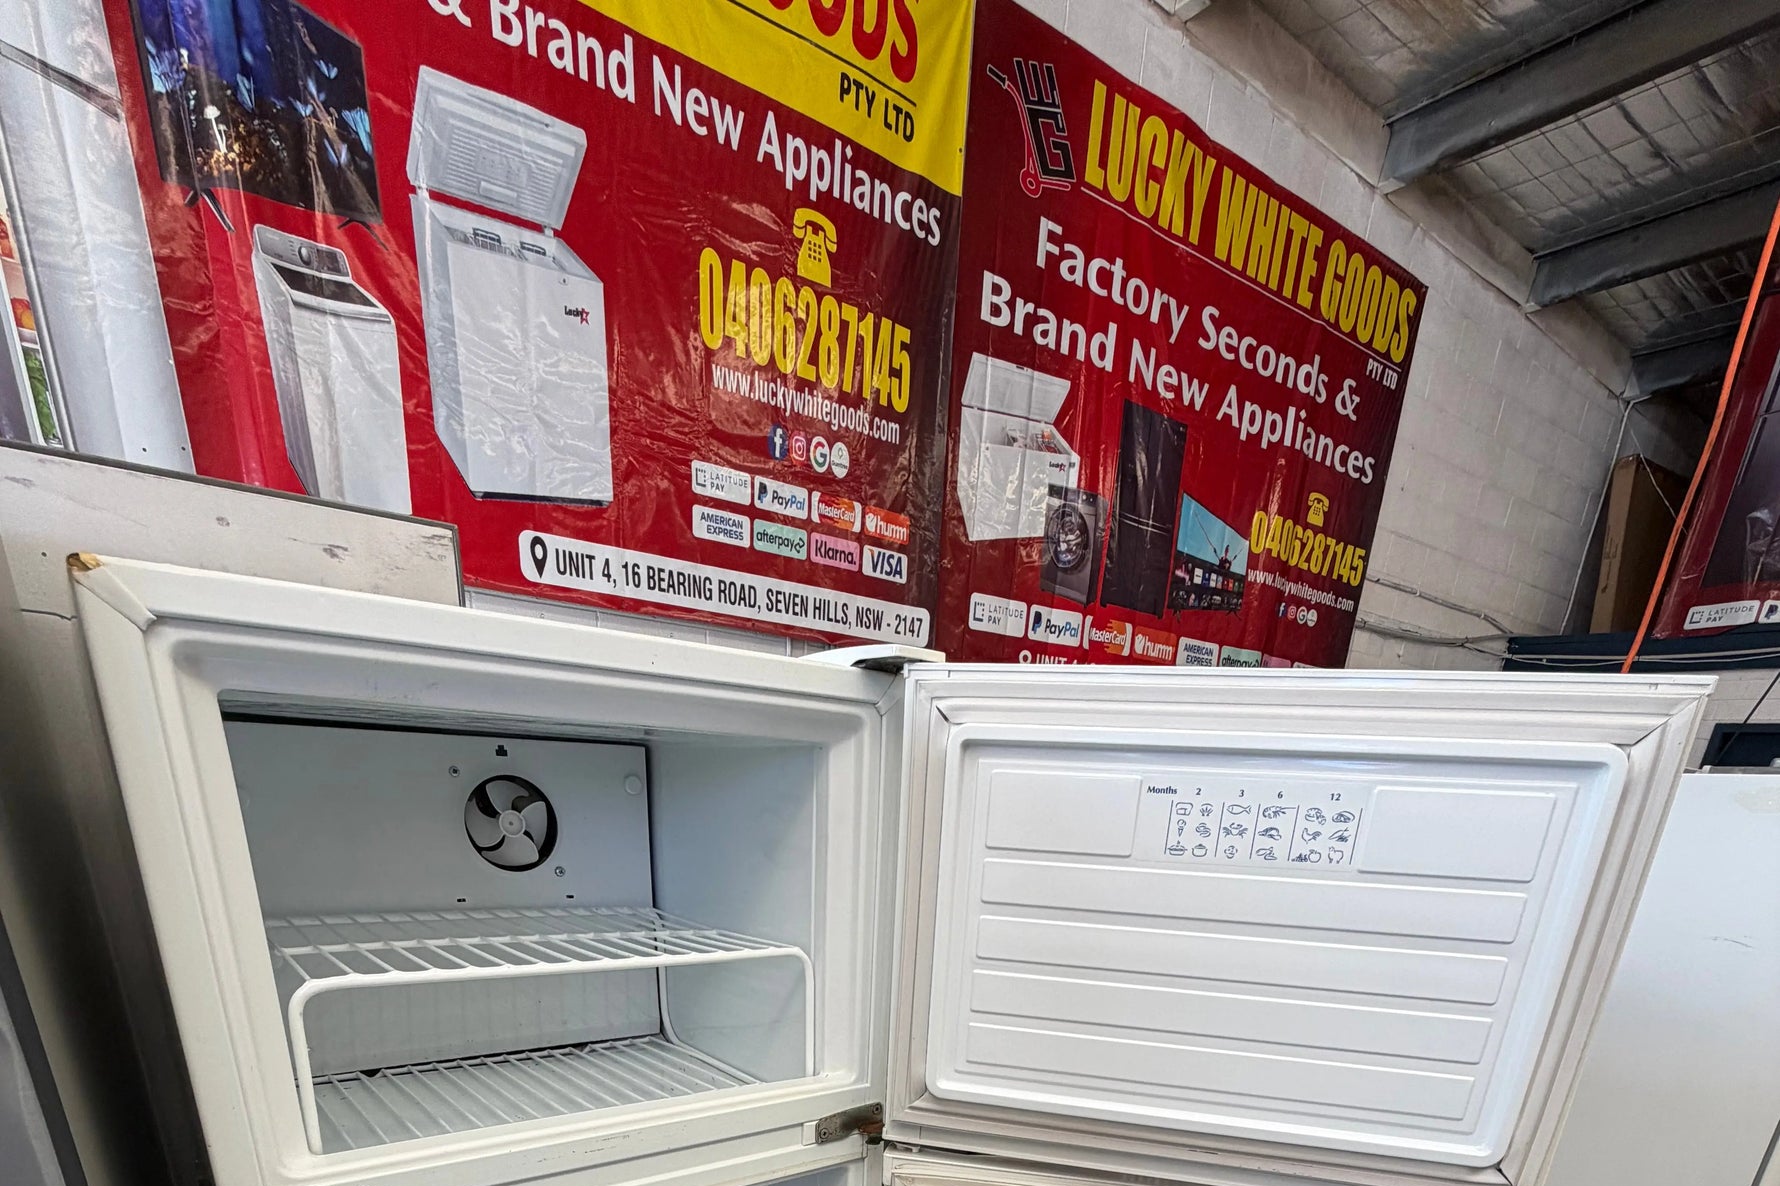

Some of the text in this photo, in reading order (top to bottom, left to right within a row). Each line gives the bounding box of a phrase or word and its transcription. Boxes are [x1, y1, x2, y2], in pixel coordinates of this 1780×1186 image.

[839, 72, 915, 143] PTY LTD
[490, 0, 941, 247] Brand New Appliances
[1084, 79, 1416, 363] LUCKY WHITE GOODS
[1036, 216, 1361, 421] Factory Seconds &
[699, 247, 911, 413] 0406287145
[980, 270, 1376, 485] Brand New Appliances
[1366, 358, 1398, 390] PTY LTD
[711, 363, 901, 445] www.luckywhitegoods.com
[709, 471, 749, 489] LATITUDE
[710, 482, 726, 493] PAY
[771, 489, 805, 512] PayPal
[700, 511, 744, 531] AMERICAN
[818, 502, 855, 523] MasterCard
[706, 524, 744, 541] EXPRESS
[756, 530, 796, 550] afterpay
[876, 519, 907, 542] humm
[1250, 510, 1367, 587] 0406287145
[868, 548, 904, 580] VISA
[555, 548, 596, 580] UNIT
[601, 557, 617, 588] 4,
[621, 561, 641, 588] 16
[647, 565, 713, 601] BEARING
[718, 579, 761, 614] ROAD,
[766, 588, 809, 618] SEVEN
[813, 597, 852, 629] HILLS,
[856, 605, 884, 632] NSW
[894, 613, 923, 639] 2147
[988, 604, 1025, 619] LATITUDE
[1708, 605, 1755, 616] LATITUDE
[987, 617, 1002, 626] PAY
[1044, 618, 1080, 638] PayPal
[1088, 627, 1127, 646] MasterCard
[1143, 640, 1173, 661] humm
[1183, 642, 1214, 658] AMERICAN
[1185, 655, 1213, 666] EXPRESS
[1146, 785, 1342, 801] Months 2 3 6 12
